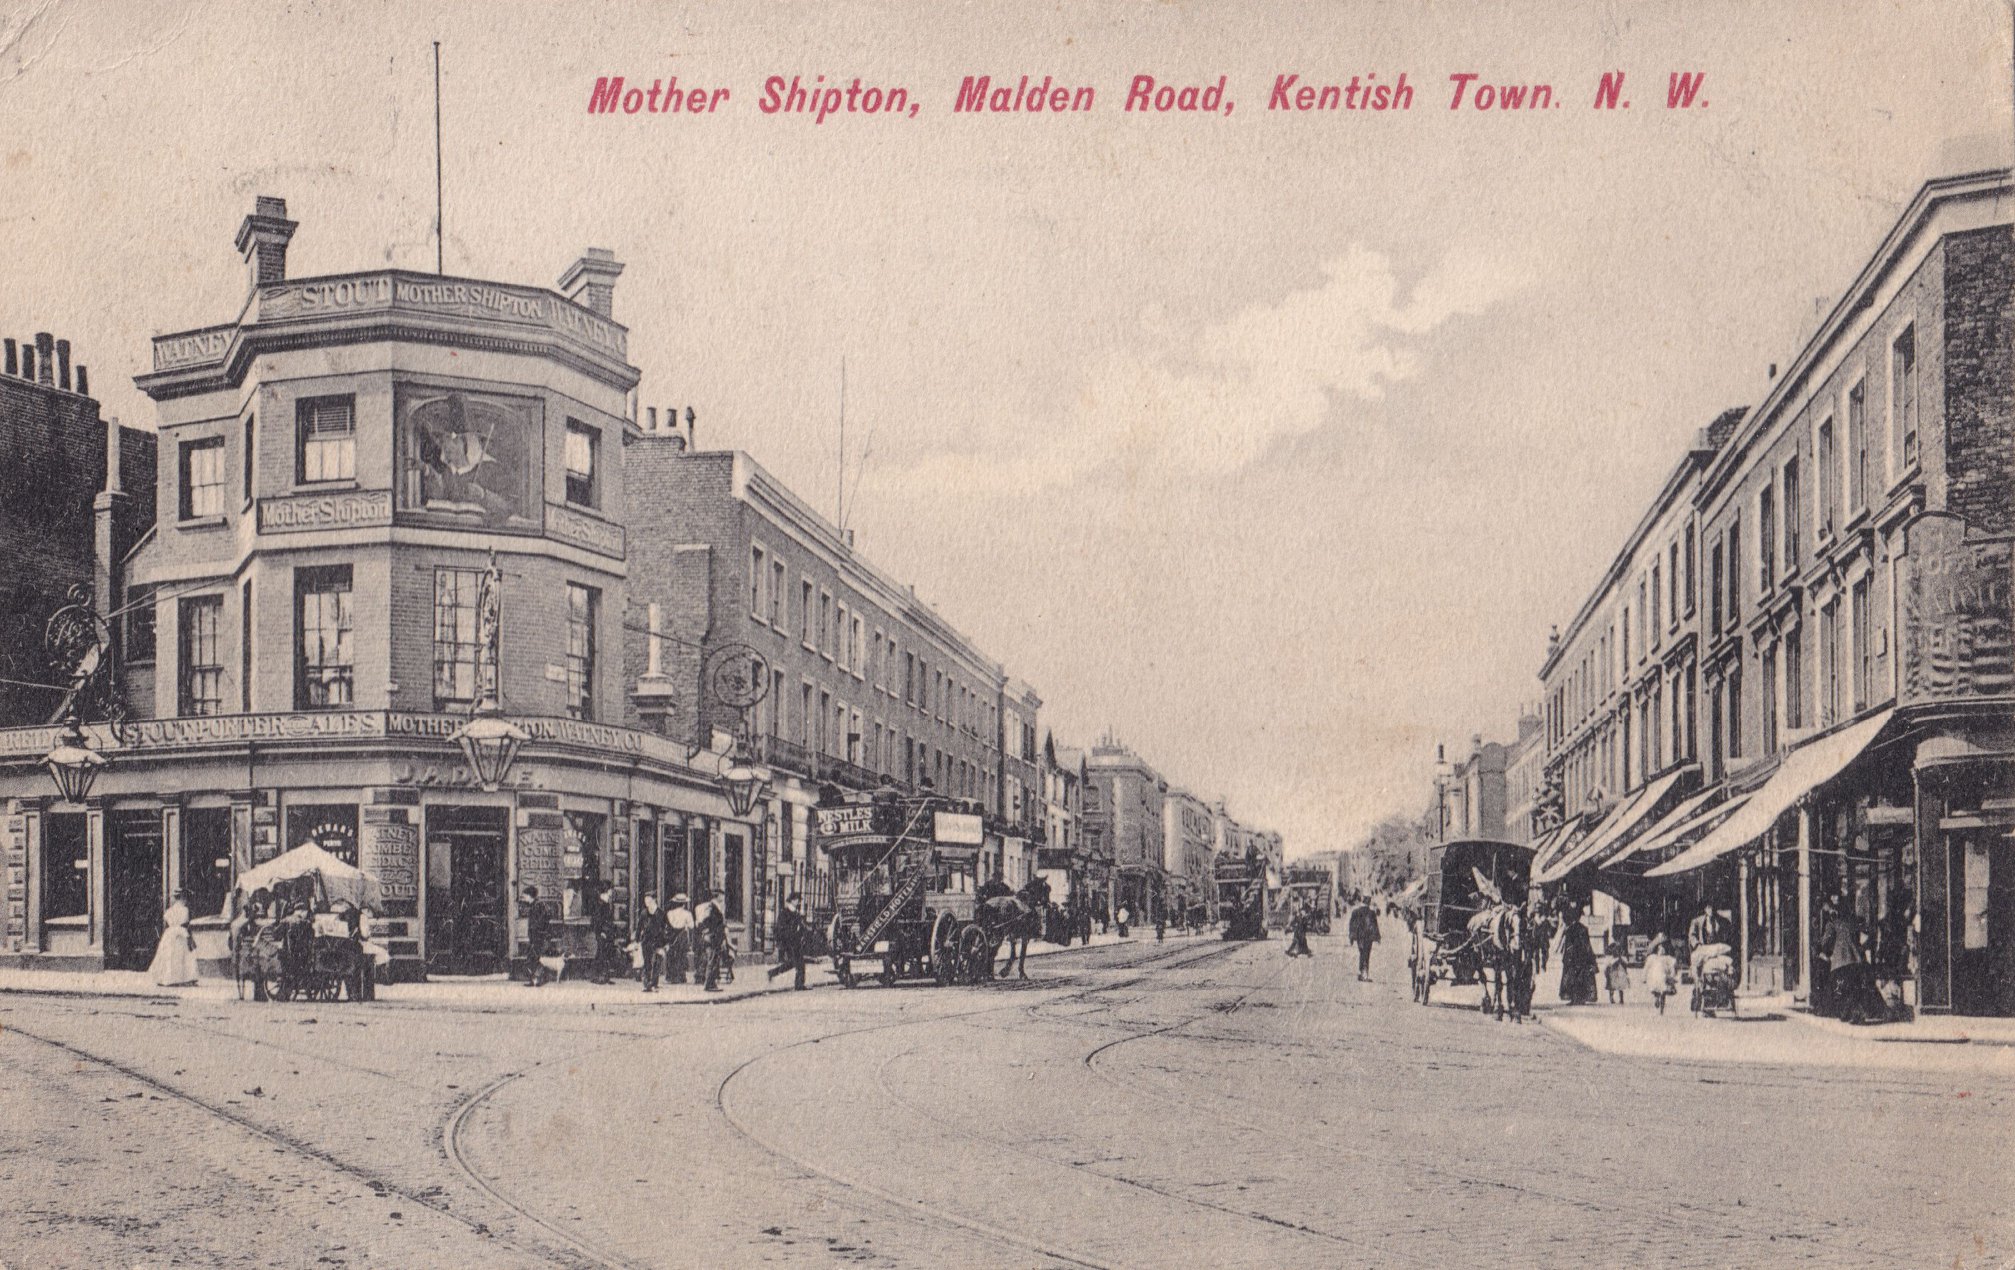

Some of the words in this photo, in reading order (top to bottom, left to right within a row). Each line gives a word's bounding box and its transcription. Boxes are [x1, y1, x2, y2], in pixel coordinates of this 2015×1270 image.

[301, 278, 390, 310] STOUT
[397, 280, 468, 306] MOTHER
[467, 284, 543, 319] SHIPTON
[261, 500, 317, 528] Mother
[319, 497, 390, 525] Shipton
[839, 819, 874, 834] MILK
[381, 883, 418, 898] OUT
